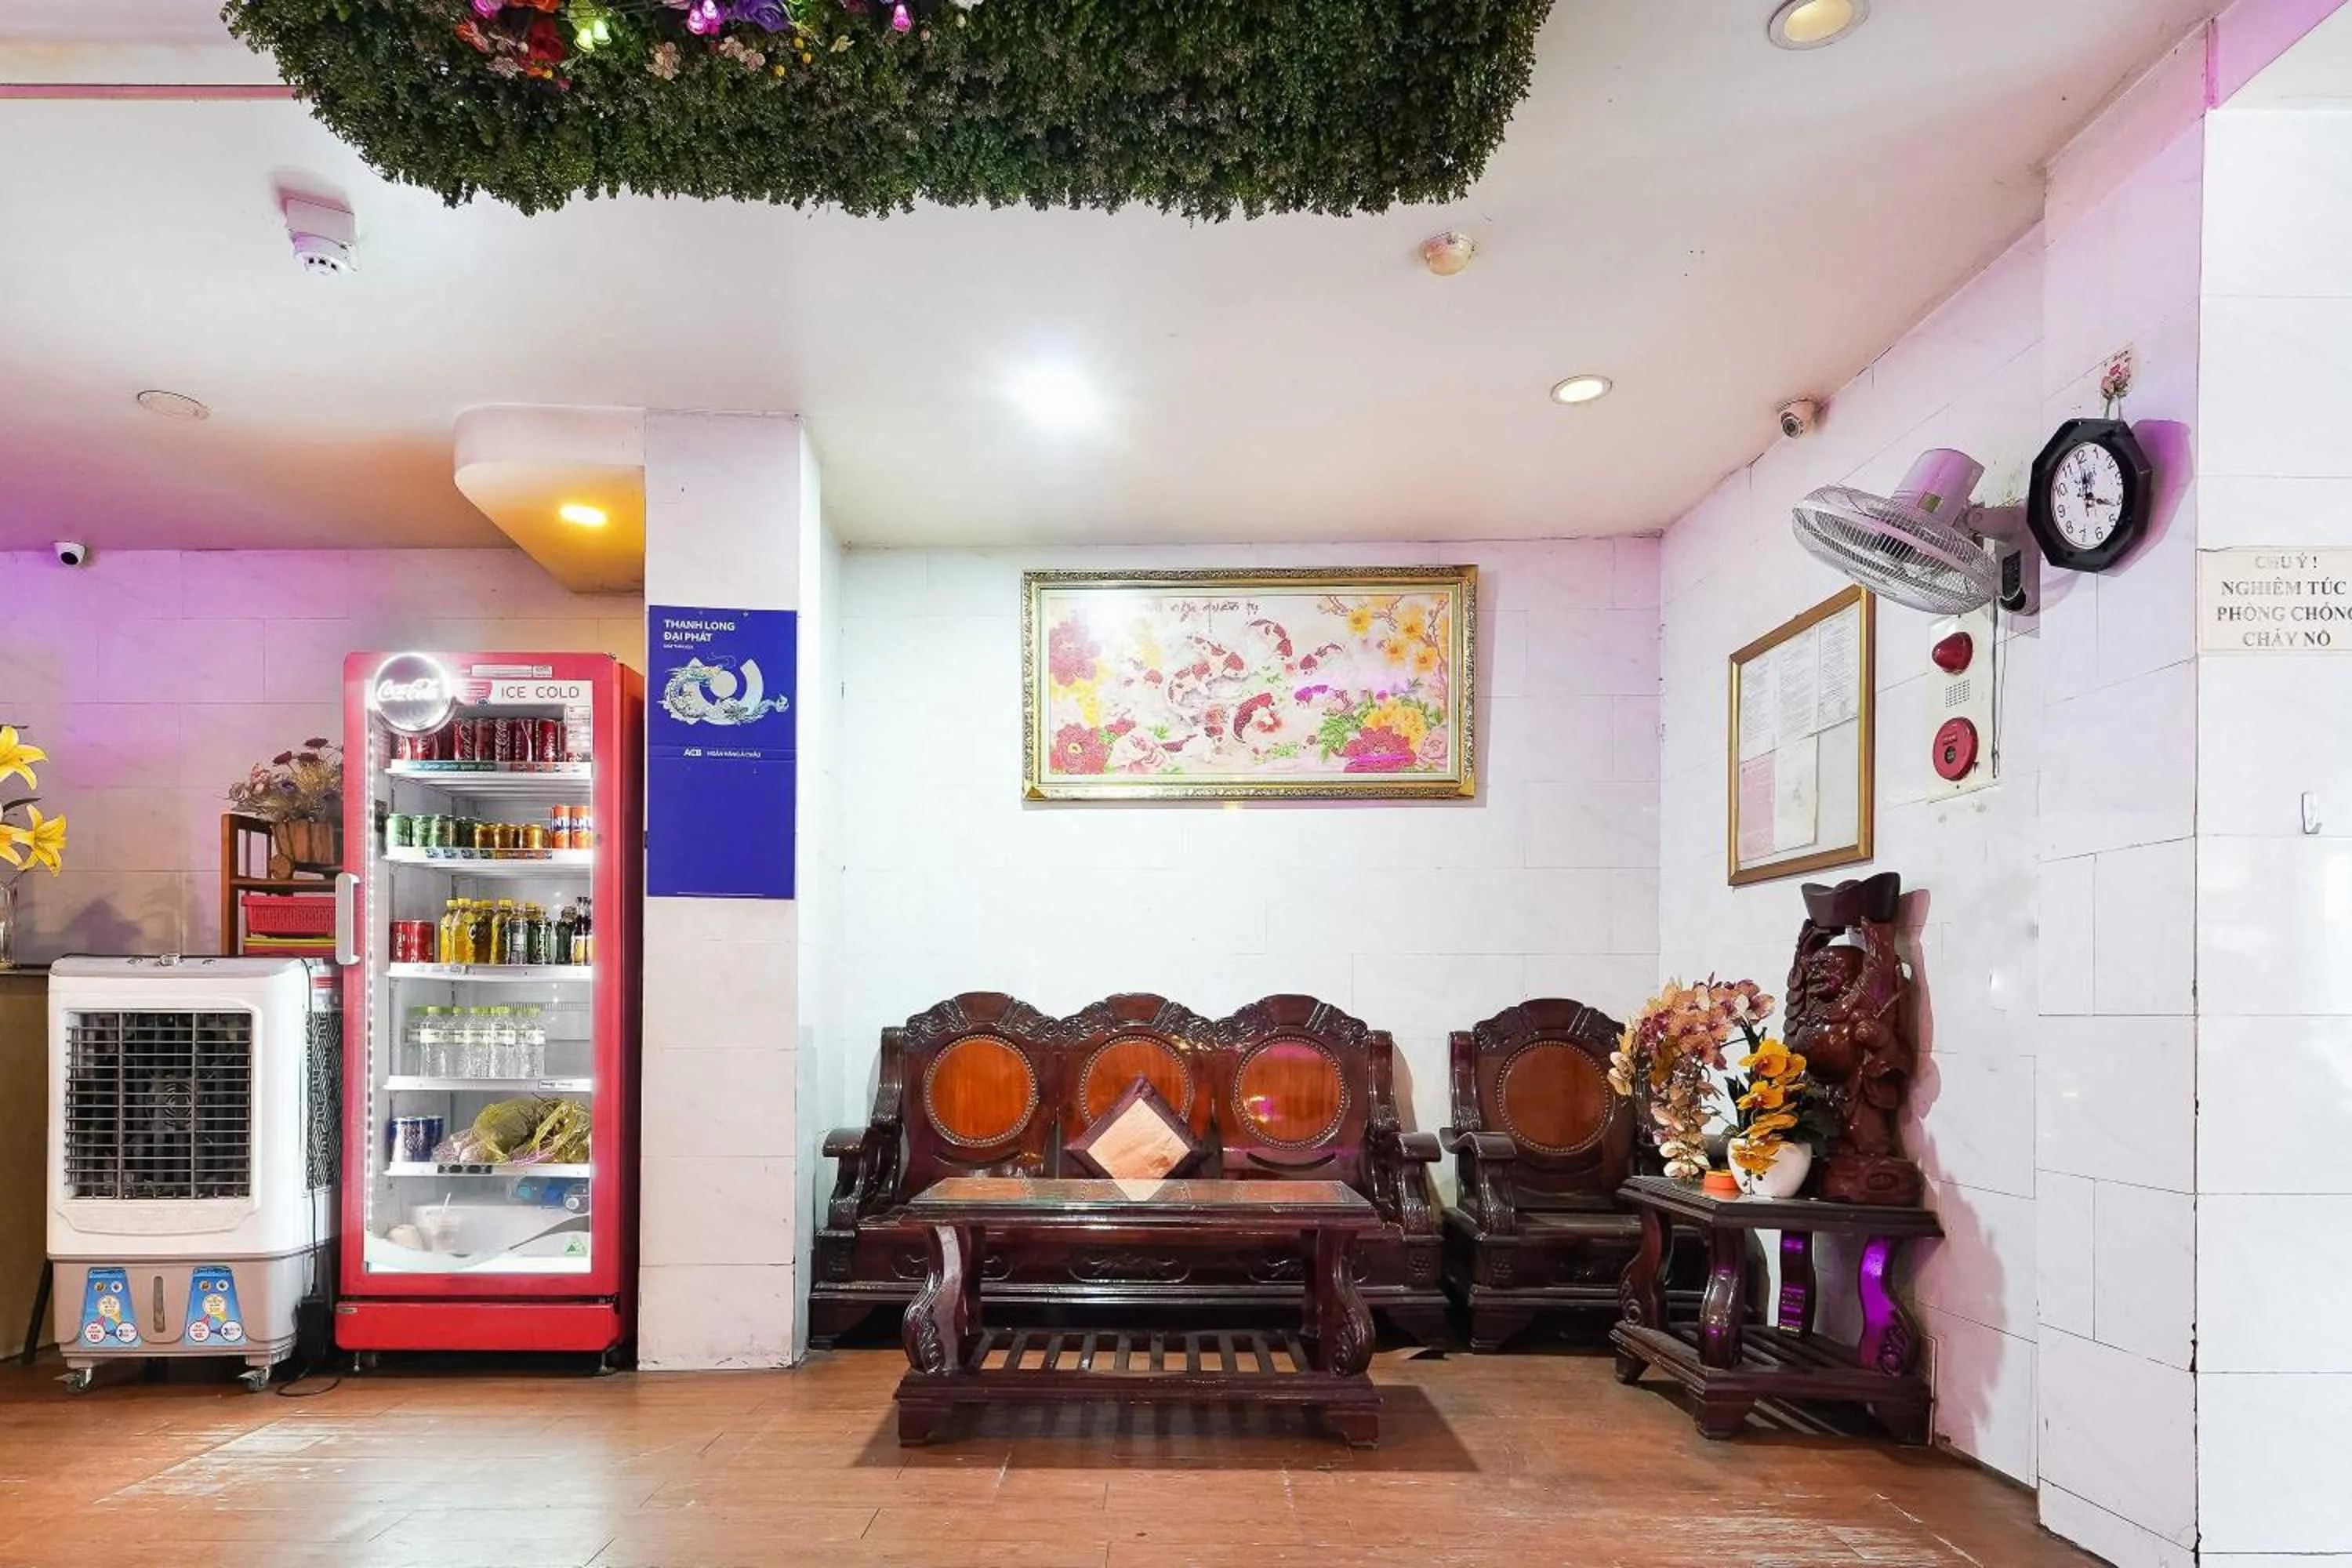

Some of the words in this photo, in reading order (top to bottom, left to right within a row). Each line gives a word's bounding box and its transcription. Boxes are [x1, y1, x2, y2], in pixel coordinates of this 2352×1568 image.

[2222, 576, 2302, 595] NGHIÊM
[2307, 576, 2347, 595] TÚC
[664, 619, 703, 629] THANH
[705, 621, 735, 631] LONG
[501, 686, 526, 698] ICE
[535, 686, 579, 698] COLD
